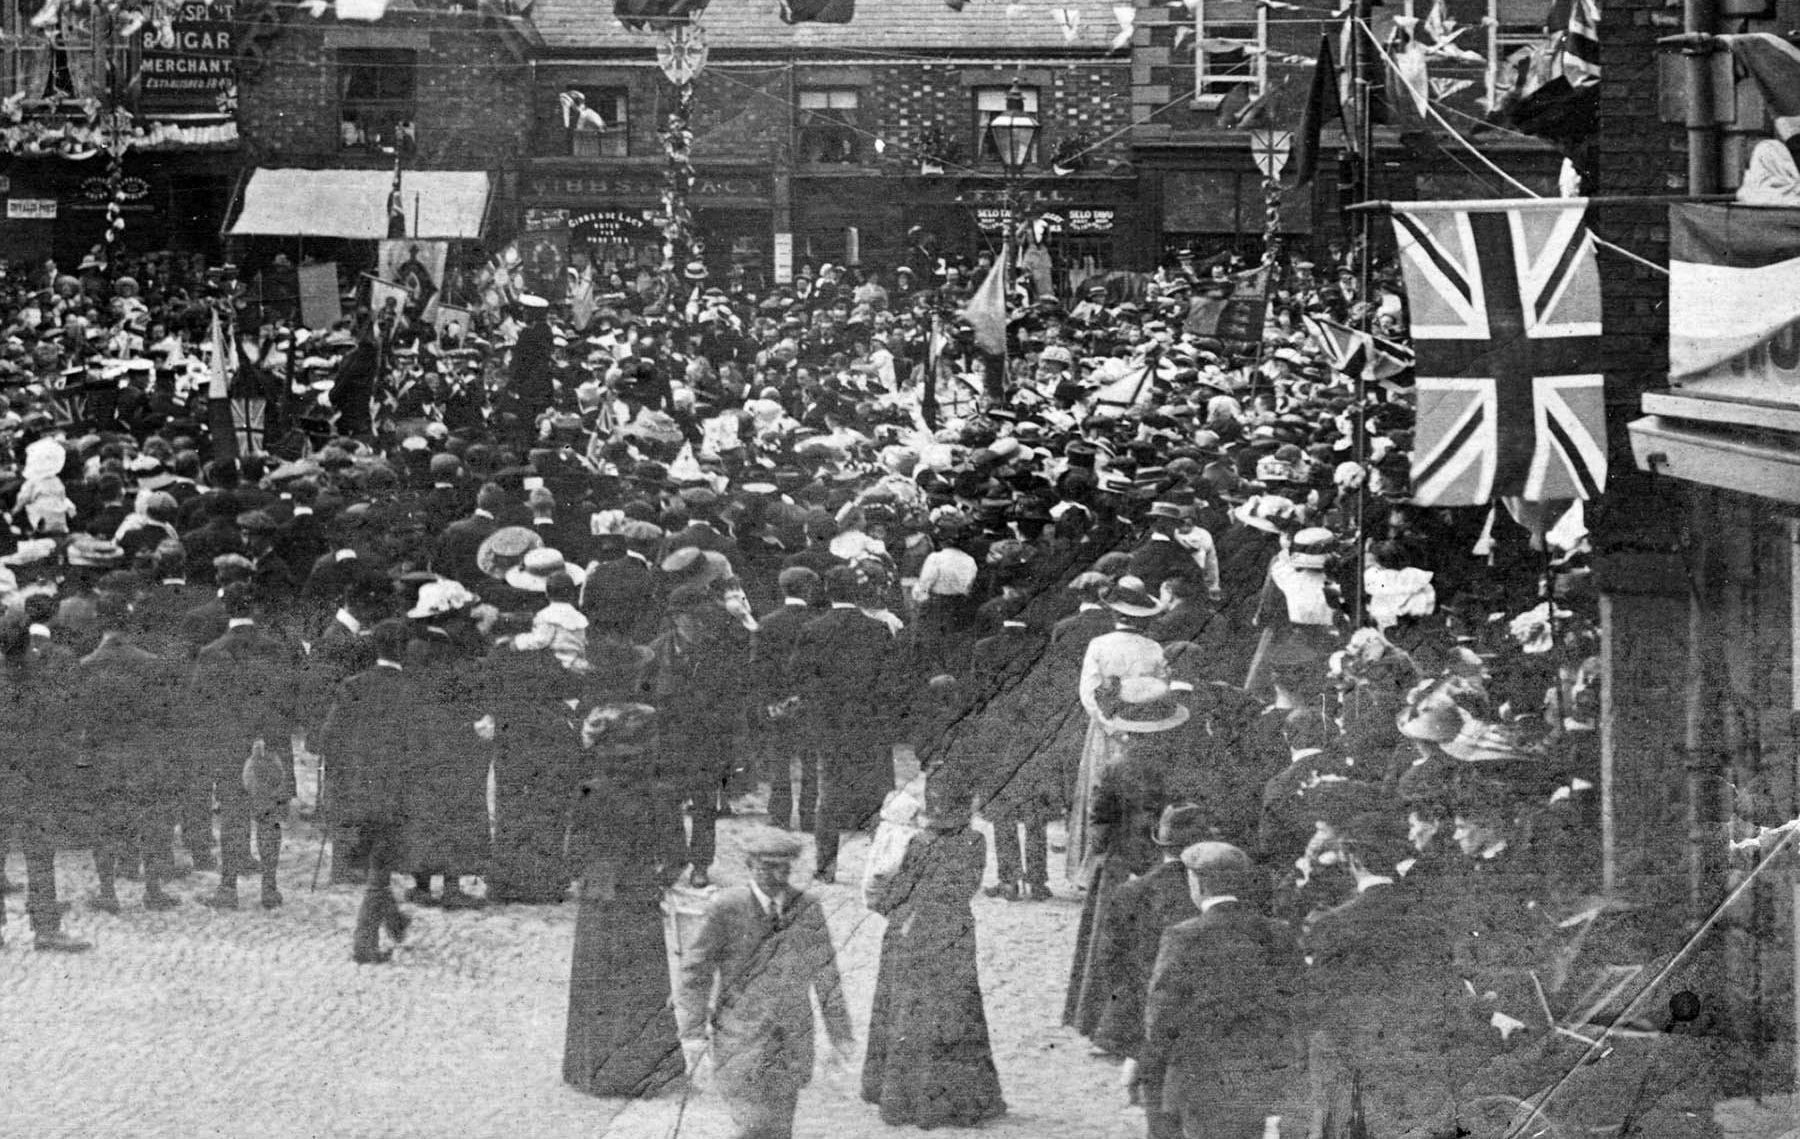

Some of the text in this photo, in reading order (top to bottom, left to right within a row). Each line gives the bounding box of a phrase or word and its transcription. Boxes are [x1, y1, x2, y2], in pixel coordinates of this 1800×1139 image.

[143, 31, 230, 49] & IGAR
[141, 59, 232, 72] MERCHANT
